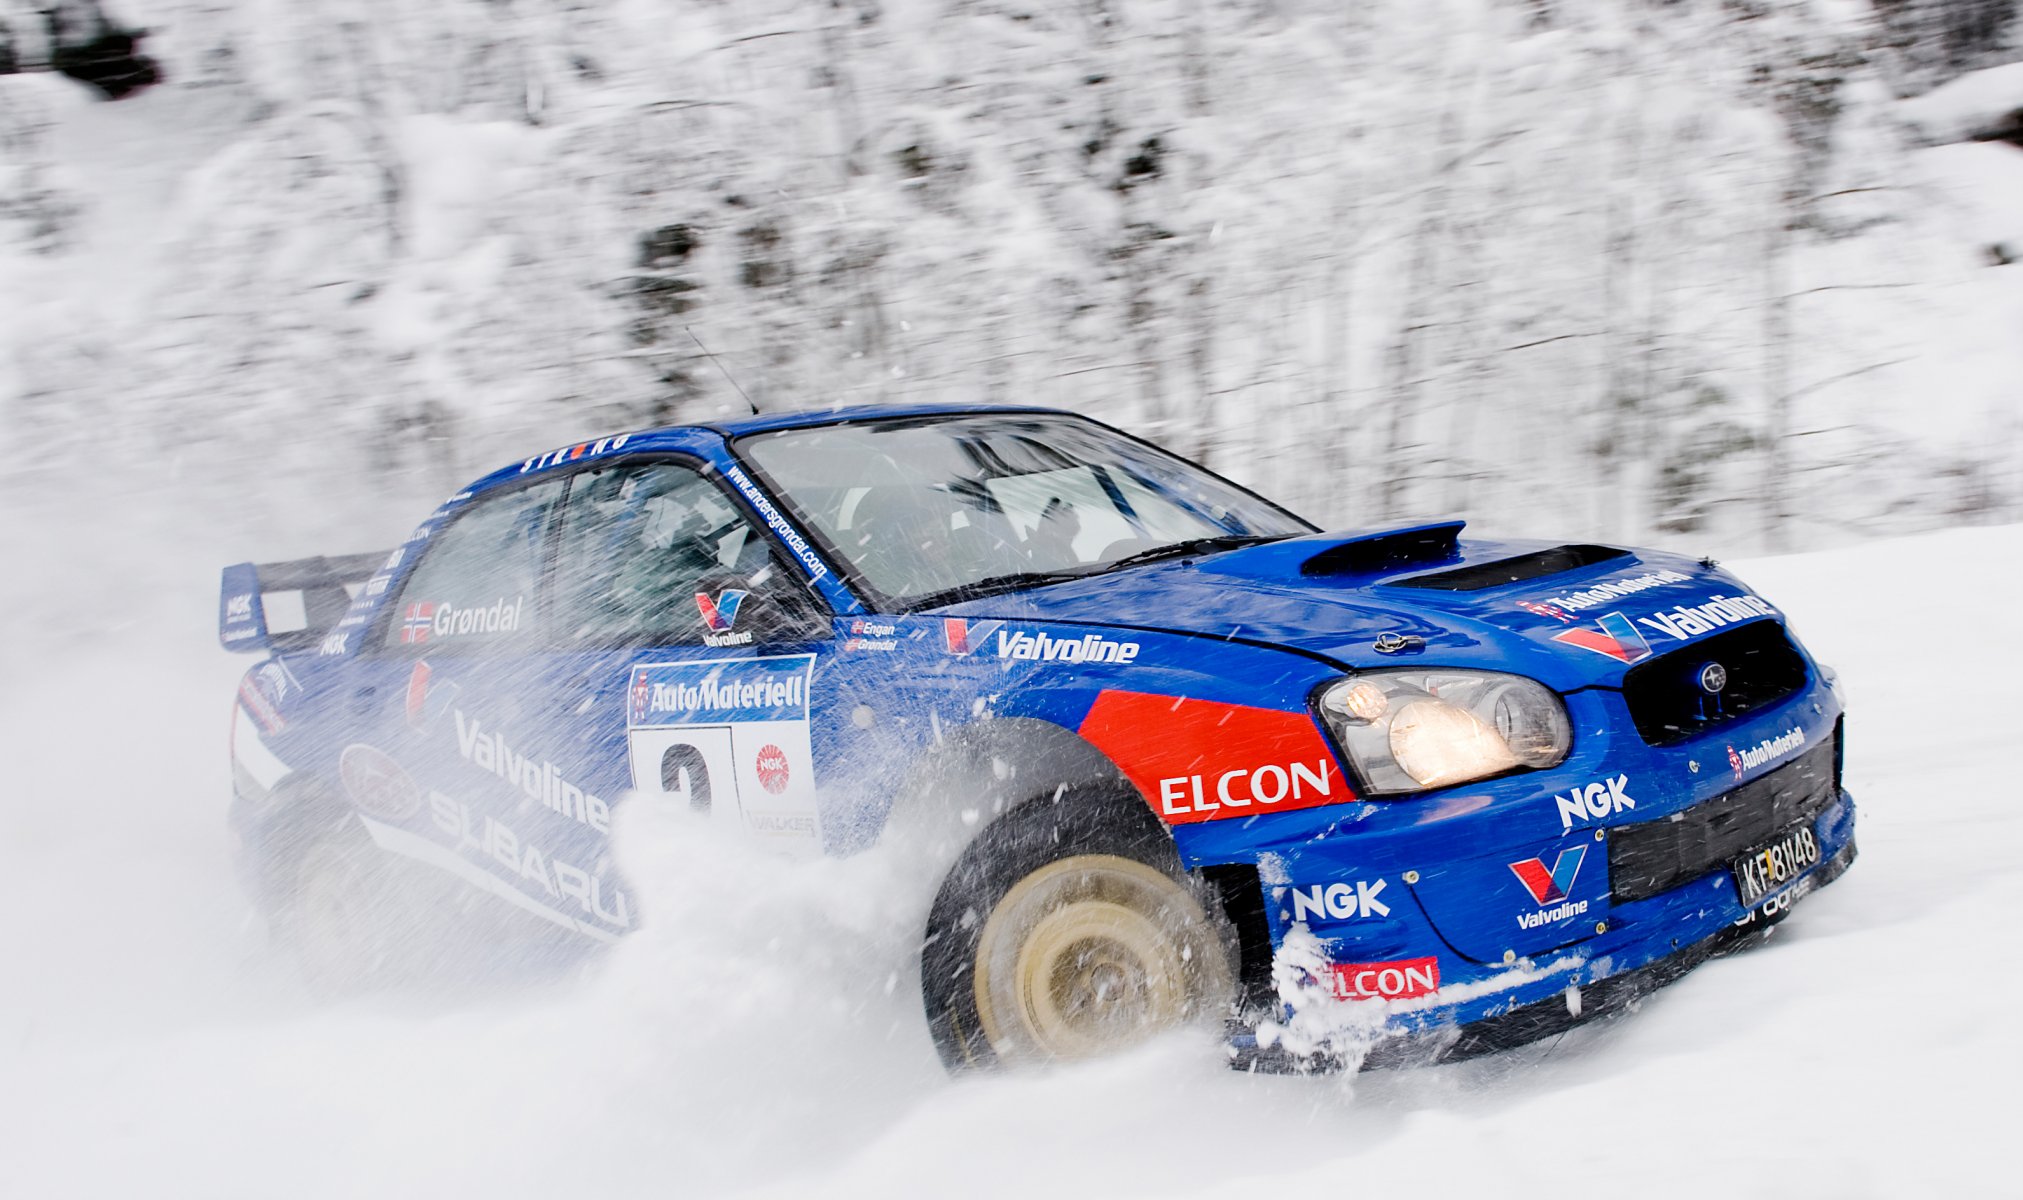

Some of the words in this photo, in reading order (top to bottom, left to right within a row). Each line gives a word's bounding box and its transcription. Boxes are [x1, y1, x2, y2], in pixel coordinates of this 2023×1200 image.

[433, 595, 524, 636] Grøndal
[863, 622, 896, 637] Engan
[1637, 593, 1777, 640] Valvoline
[702, 630, 753, 648] Valvoline
[998, 630, 1140, 664] Valvoline
[650, 674, 803, 713] AutoMateriell
[759, 757, 784, 771] NGK
[1739, 727, 1806, 772] AutoMateriell
[454, 709, 610, 835] Valvoline
[1159, 759, 1331, 815] ELCON
[1554, 773, 1636, 829] NGK
[429, 790, 631, 928] SUBARU
[1743, 853, 1768, 899] KF
[1771, 827, 1817, 882] 81148
[1292, 878, 1391, 921] NGK
[1517, 899, 1588, 930] Valvoline
[1330, 964, 1436, 998] LCON
